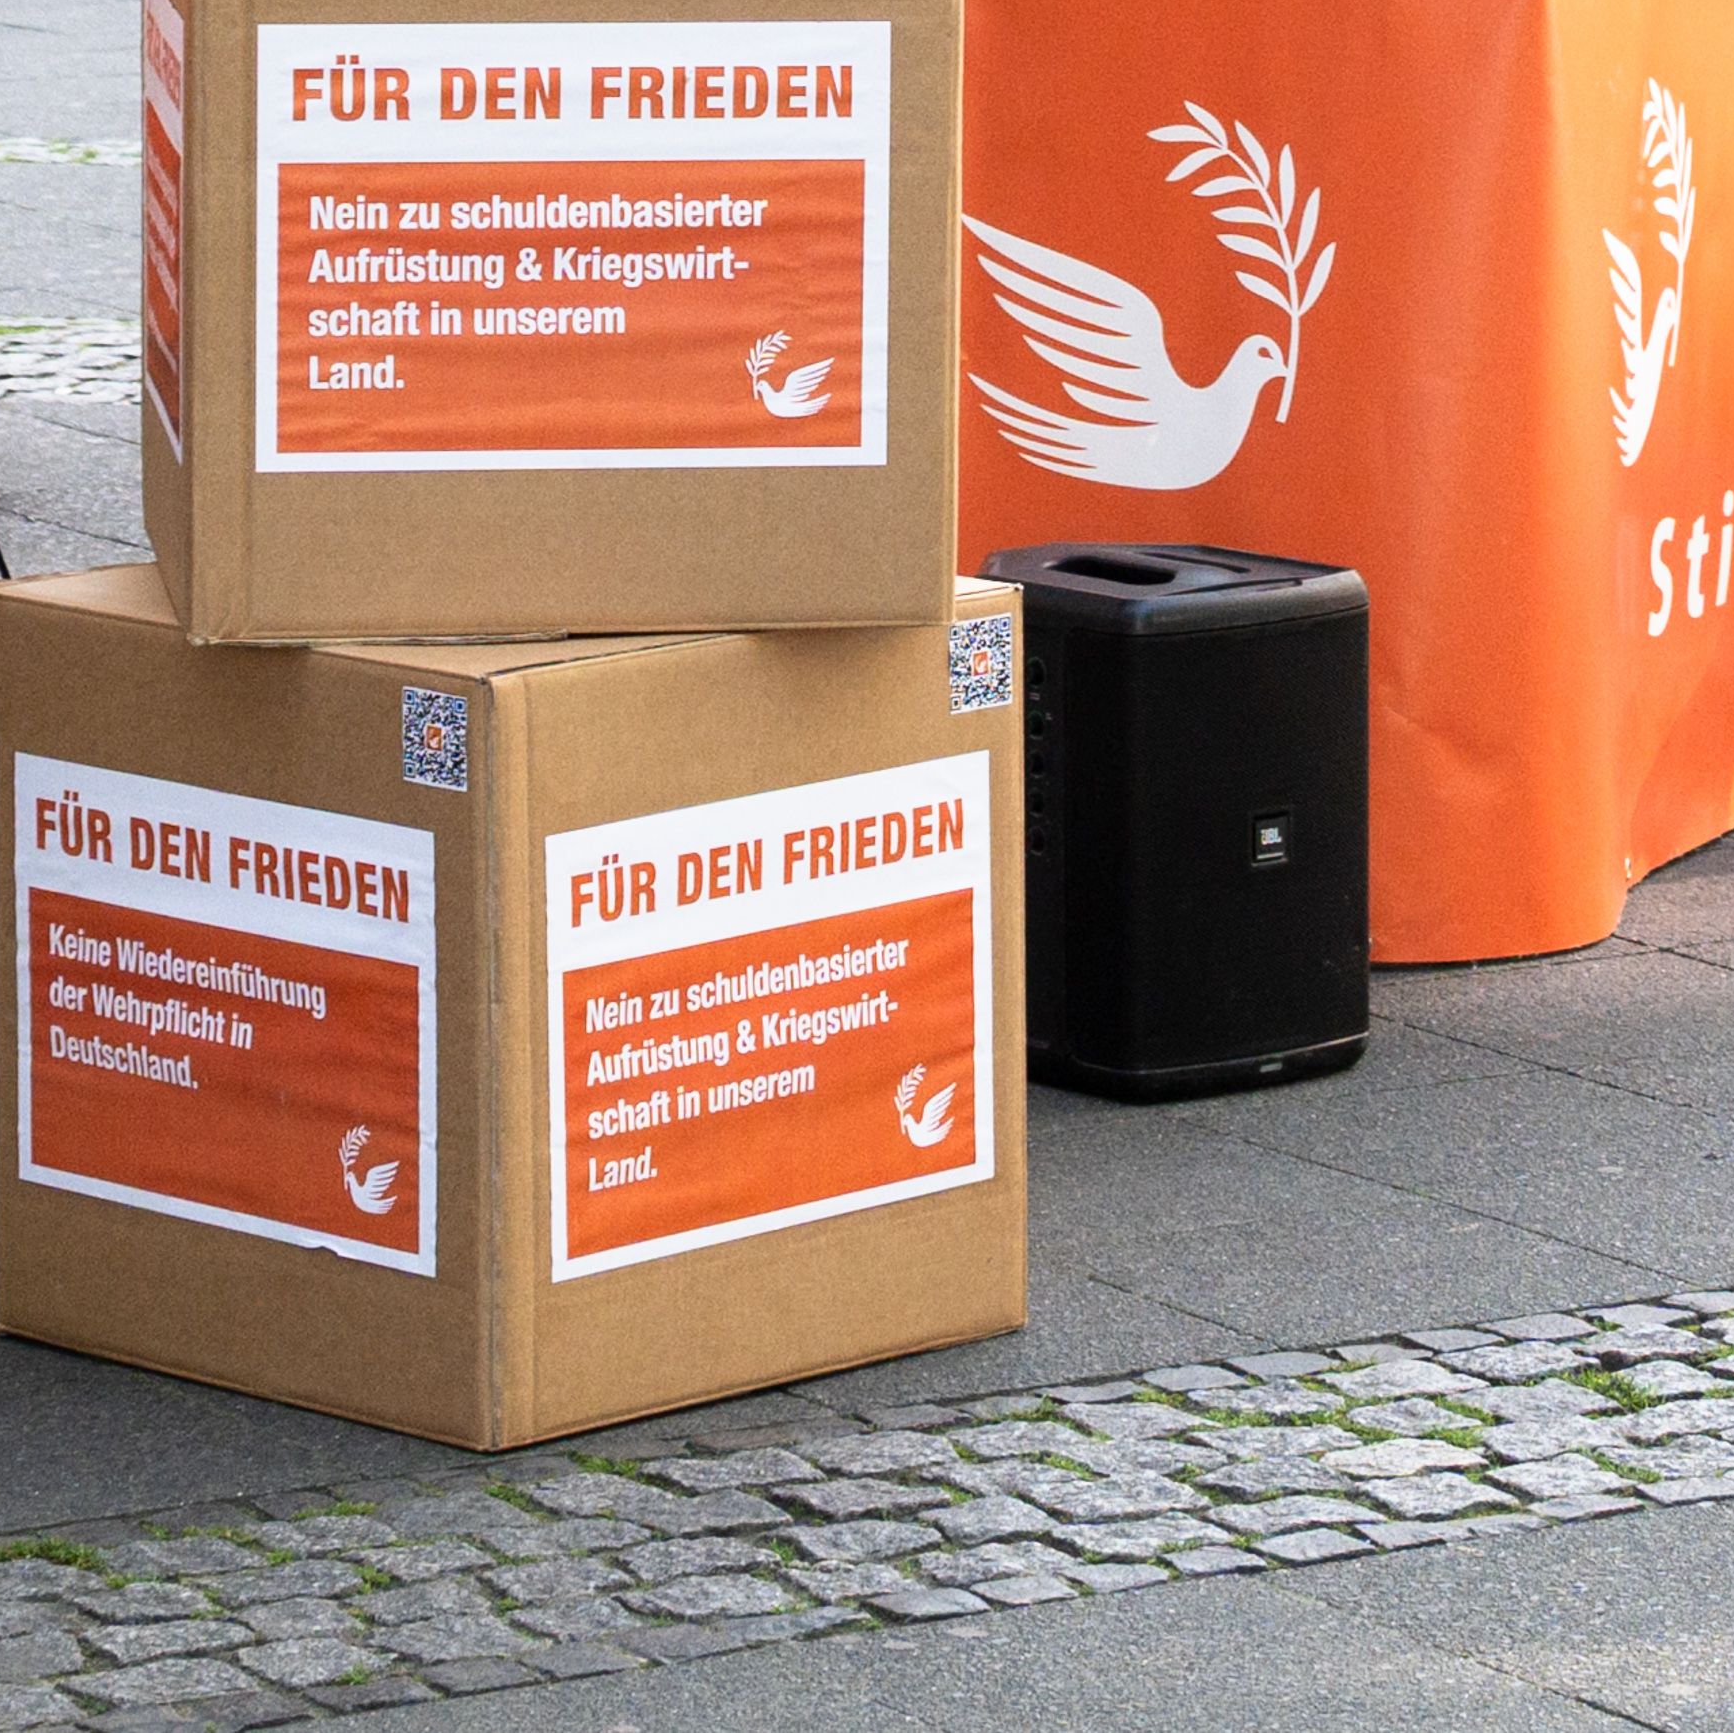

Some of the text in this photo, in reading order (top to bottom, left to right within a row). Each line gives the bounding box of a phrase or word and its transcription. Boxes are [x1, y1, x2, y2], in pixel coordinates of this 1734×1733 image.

[292, 54, 854, 123] FÜR DEN FRIEDEN
[308, 194, 768, 232] Nein zu schuldenbasierter
[308, 245, 750, 289] Aufrüstung & Kriegswirt-
[308, 300, 627, 338] schaft in unserem
[308, 355, 406, 391] Land.
[36, 789, 411, 923] FÜR DEN FRIEDEN
[570, 797, 965, 929] FÜR DEN FRIEDEN
[1260, 826, 1282, 845] JBL
[49, 923, 327, 1021] Keine Wiedereinführung
[585, 939, 910, 1035] Nein zu schuldenbasierter
[49, 975, 254, 1050] der Wehrpflicht in
[586, 988, 900, 1088] Aufrüstung & Kriegswirt-
[49, 1024, 200, 1091] Deutschland.
[587, 1063, 816, 1140] schaft in unserem
[587, 1144, 659, 1194] Land.
